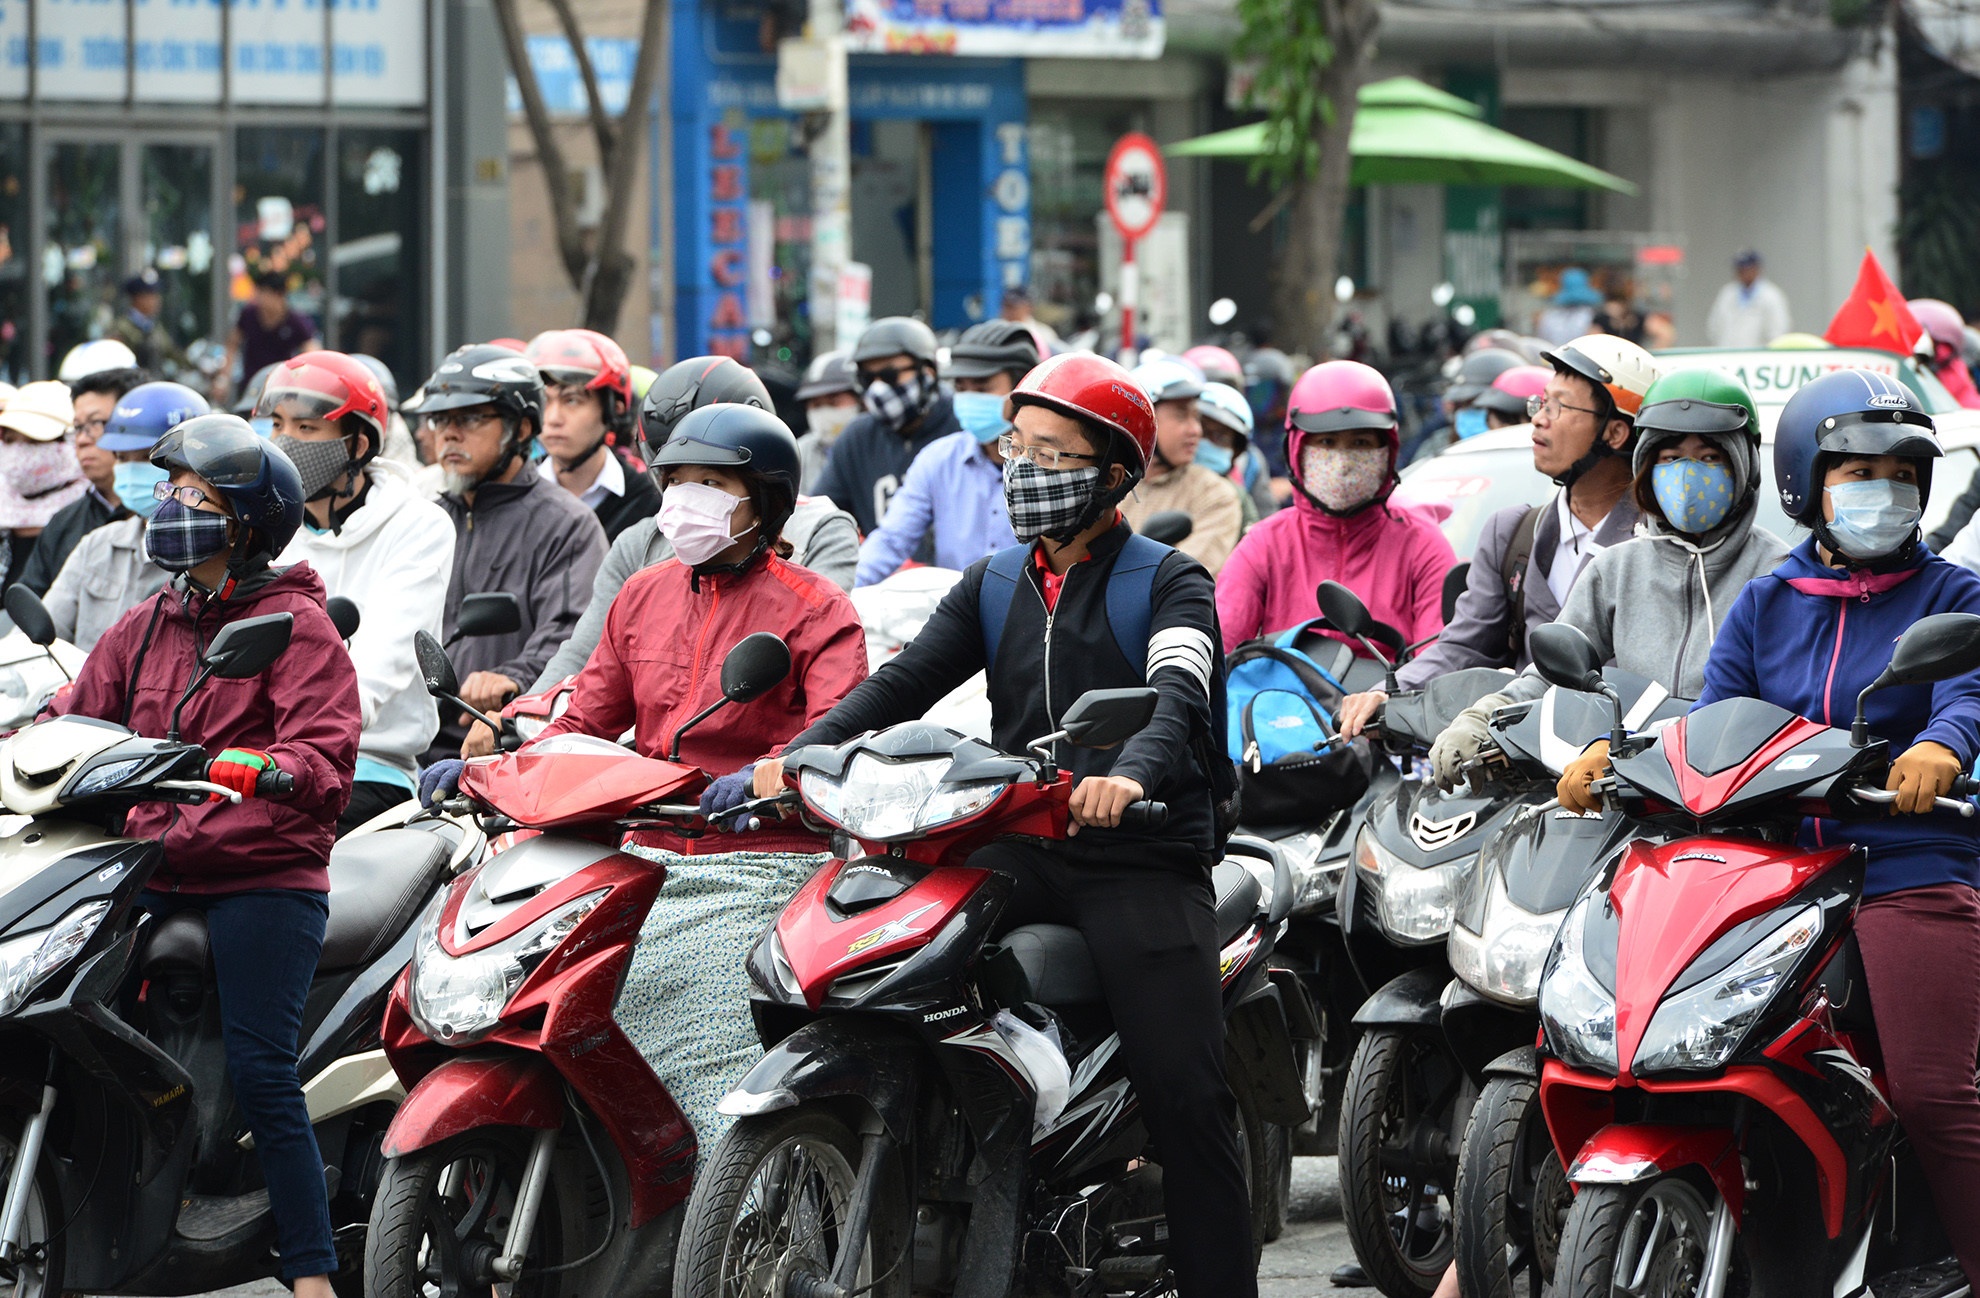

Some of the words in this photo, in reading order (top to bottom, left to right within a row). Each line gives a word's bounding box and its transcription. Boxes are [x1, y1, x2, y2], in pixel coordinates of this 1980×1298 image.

[1554, 811, 1604, 820] HONDA
[1673, 853, 1727, 864] HONDA
[844, 865, 892, 878] HONDA
[923, 1005, 968, 1023] HONDA
[153, 1084, 186, 1108] YAMAHA
